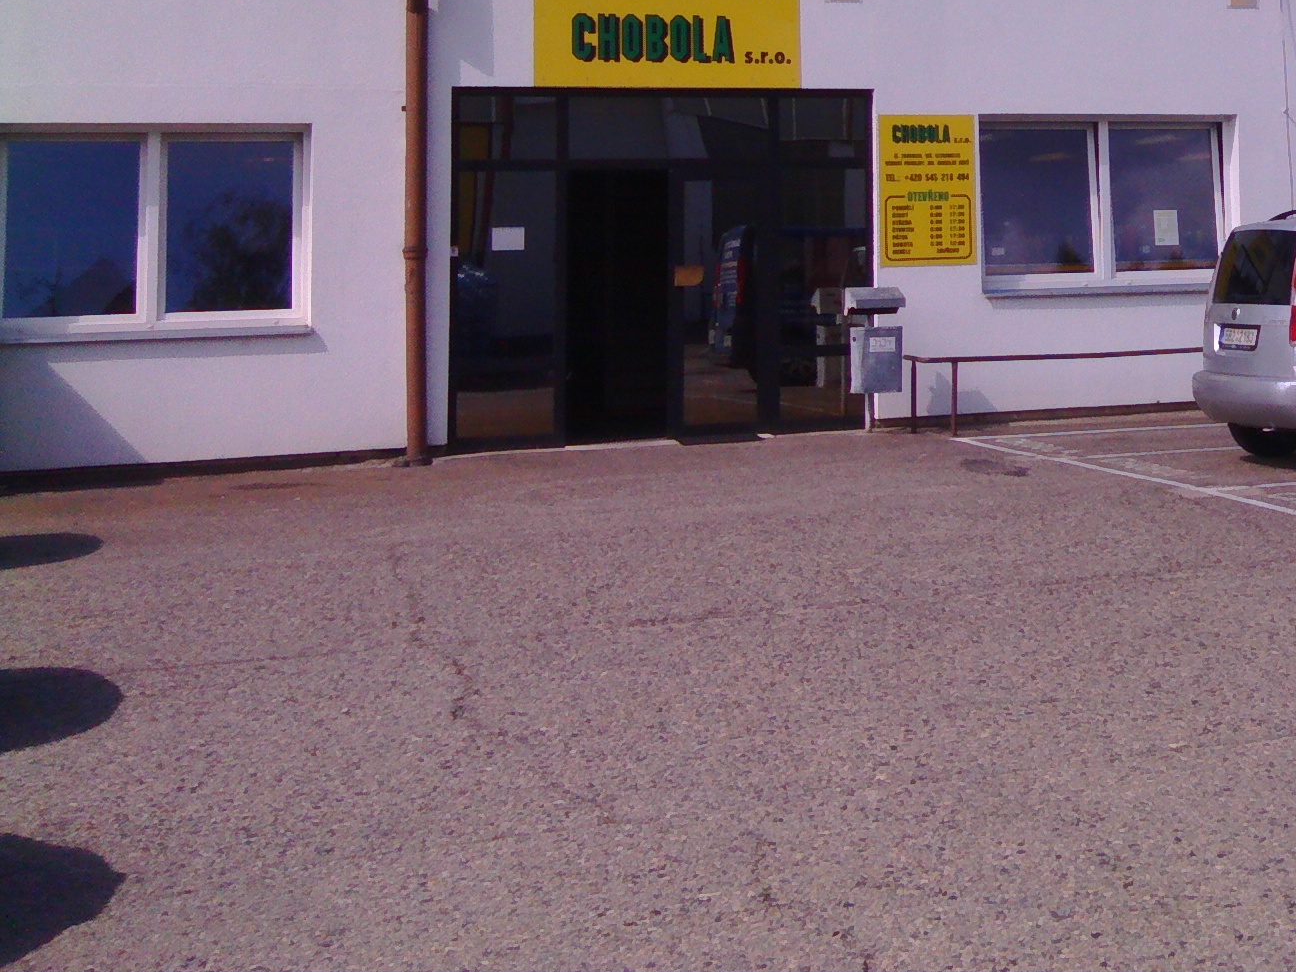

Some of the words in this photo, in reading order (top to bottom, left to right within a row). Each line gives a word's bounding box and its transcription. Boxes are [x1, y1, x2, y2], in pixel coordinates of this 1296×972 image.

[571, 12, 735, 63] CHOBOLA
[744, 50, 792, 64] s.r.o.
[892, 124, 950, 144] CHOBOLA
[907, 189, 949, 202] OTEVŘENO
